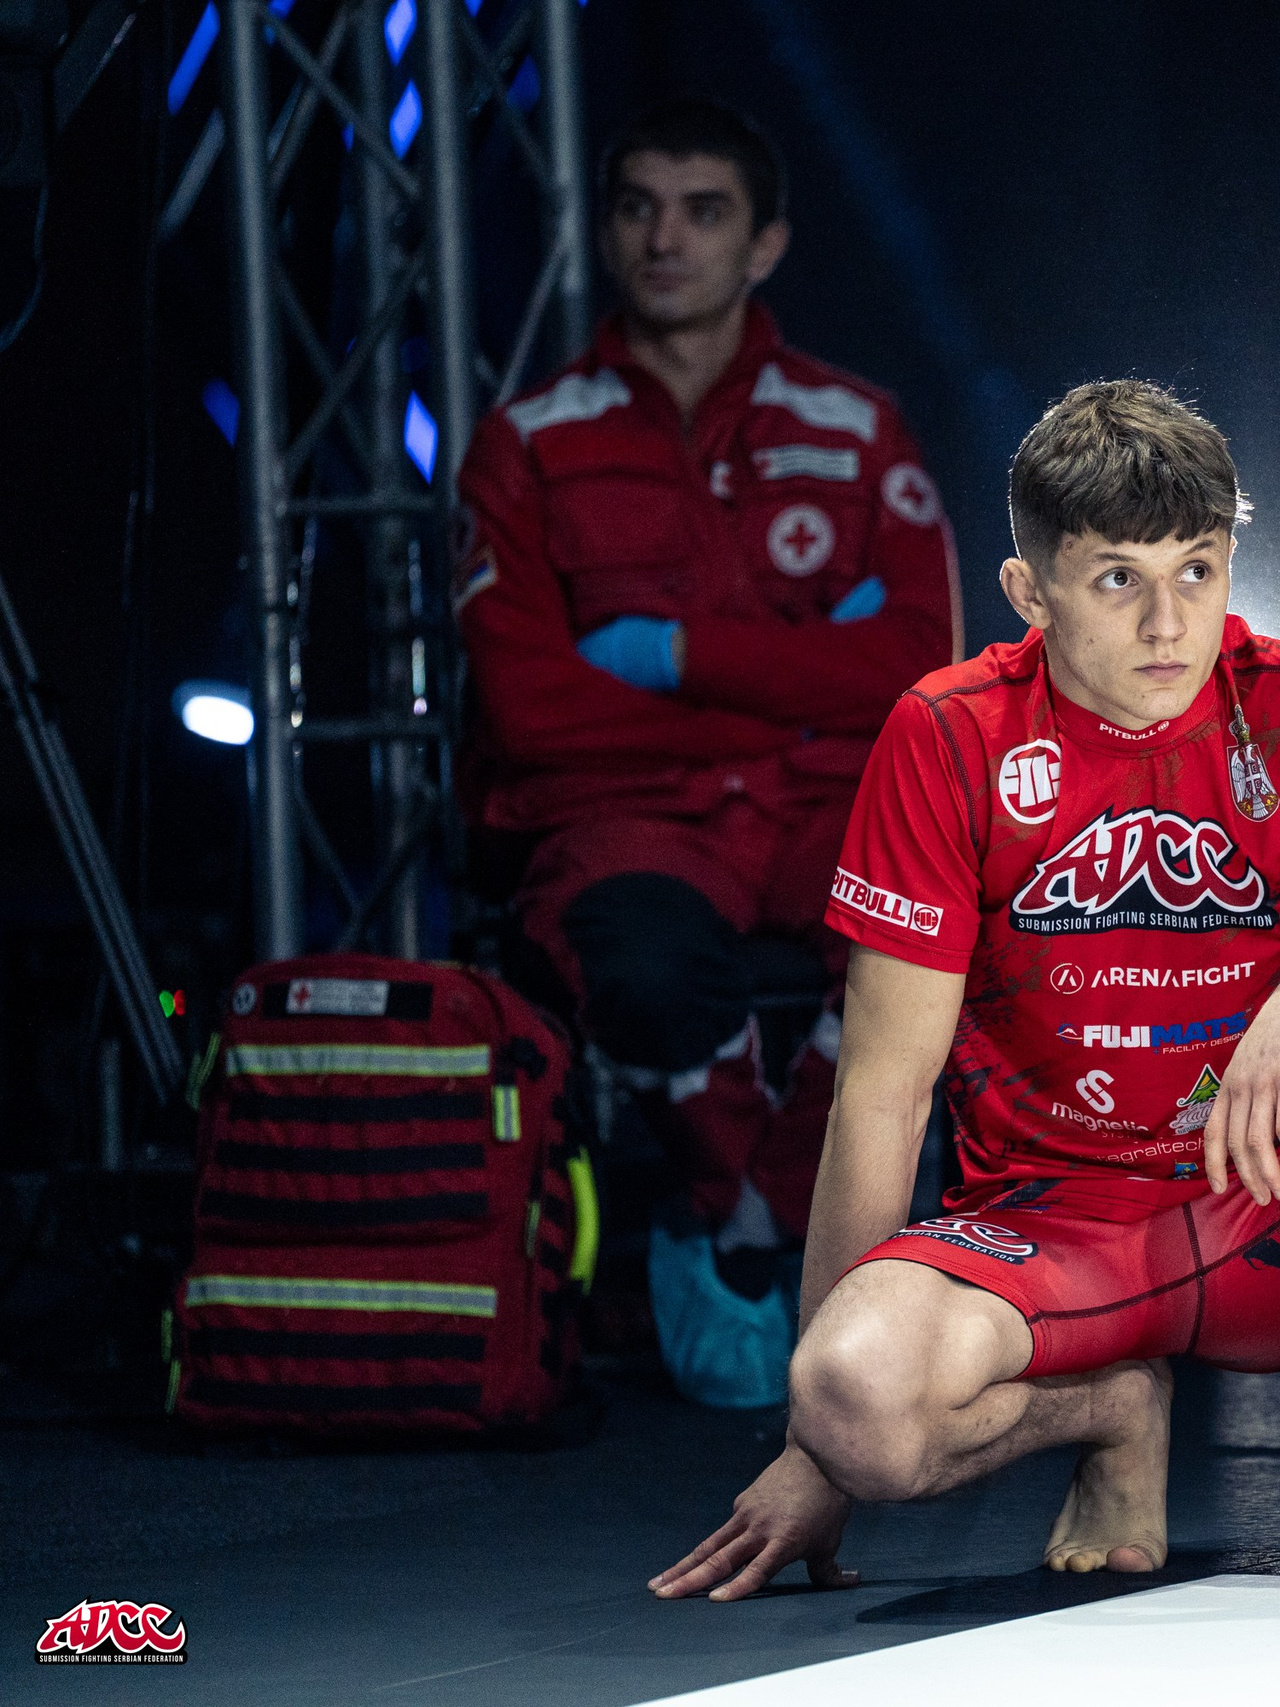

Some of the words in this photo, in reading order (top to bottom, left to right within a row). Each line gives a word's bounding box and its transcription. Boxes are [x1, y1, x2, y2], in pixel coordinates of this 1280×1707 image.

[1099, 722, 1157, 741] PITBULL
[1012, 807, 1265, 916] ADCC
[1018, 916, 1091, 933] SUBMISSION
[1095, 910, 1146, 929] FIGHTING
[1150, 912, 1198, 930] SERBIAN
[1202, 913, 1273, 928] FEDERATION
[1083, 1011, 1248, 1049] FUJIMATS
[1162, 1041, 1208, 1055] FACILITY
[1210, 1031, 1244, 1047] DESIGN
[944, 1236, 1016, 1263] FEDERATION
